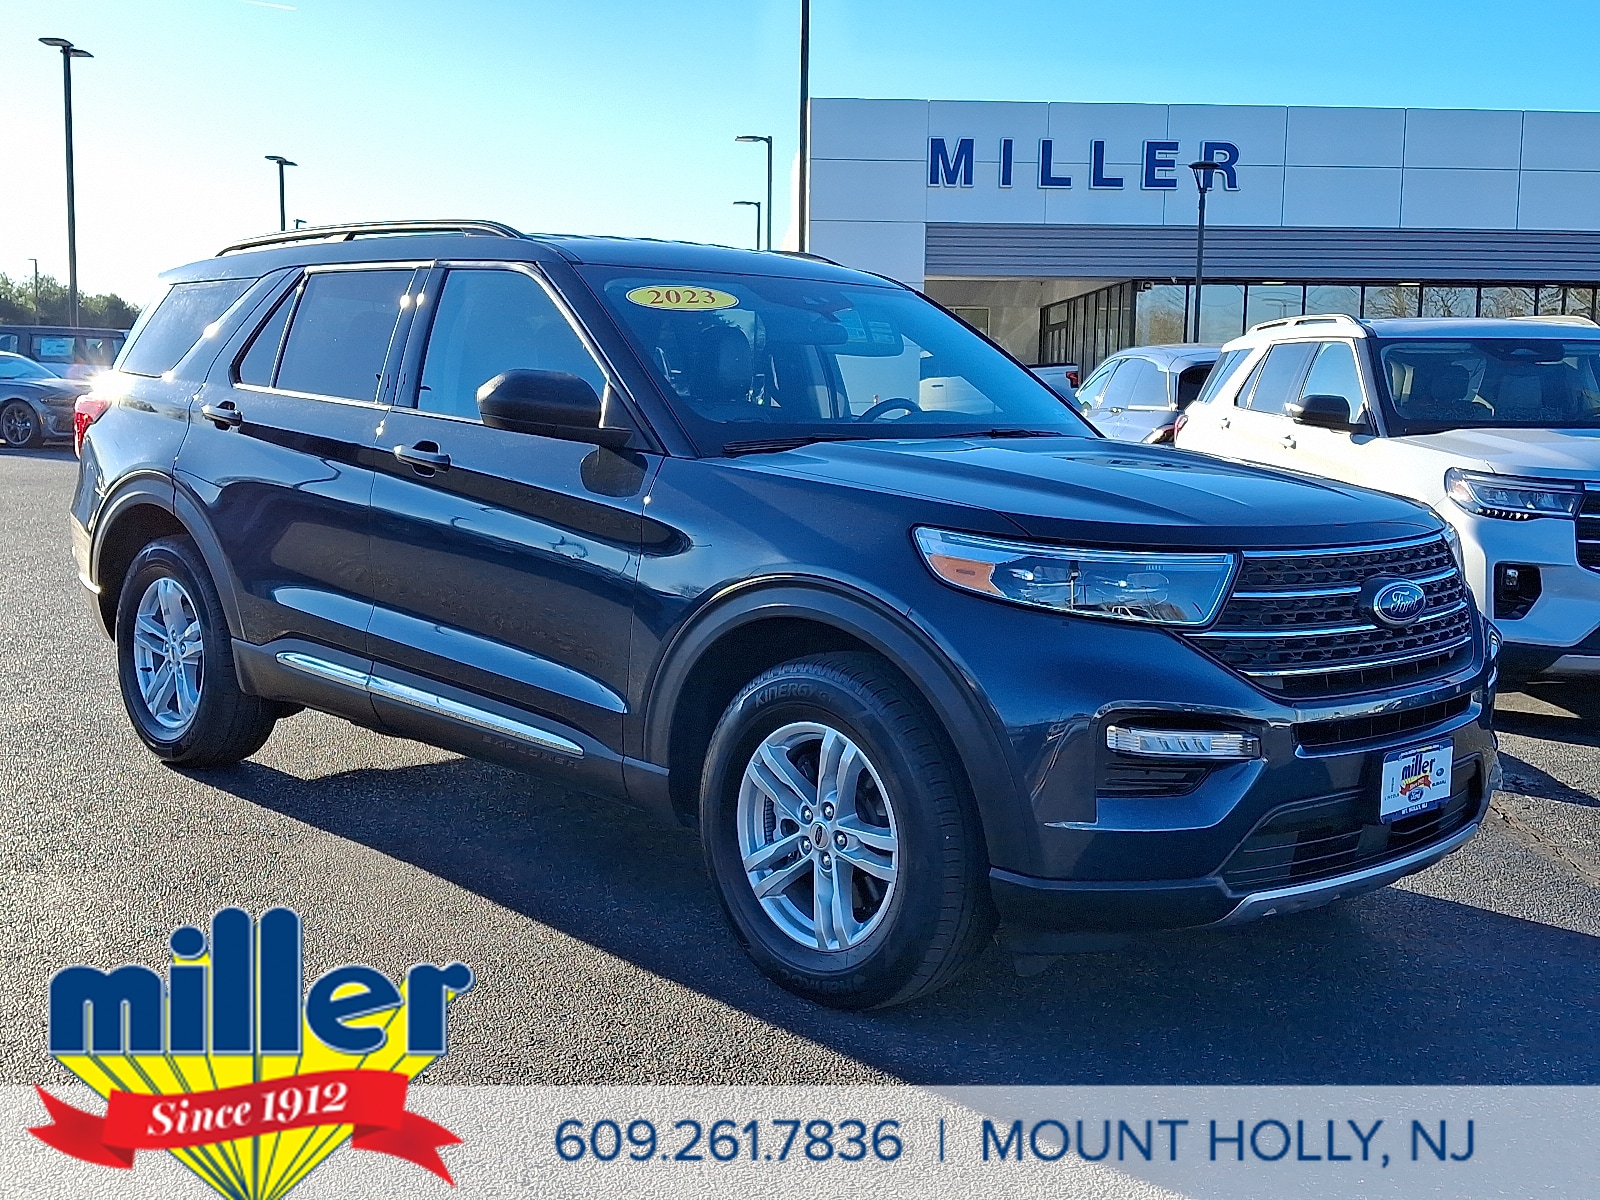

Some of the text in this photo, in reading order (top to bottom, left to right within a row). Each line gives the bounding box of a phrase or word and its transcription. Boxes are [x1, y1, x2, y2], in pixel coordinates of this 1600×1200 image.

[927, 136, 1240, 191] MILLER
[648, 289, 716, 304] 2023
[1390, 590, 1419, 615] Ford
[755, 682, 814, 707] KINERGY
[1401, 753, 1436, 781] miller
